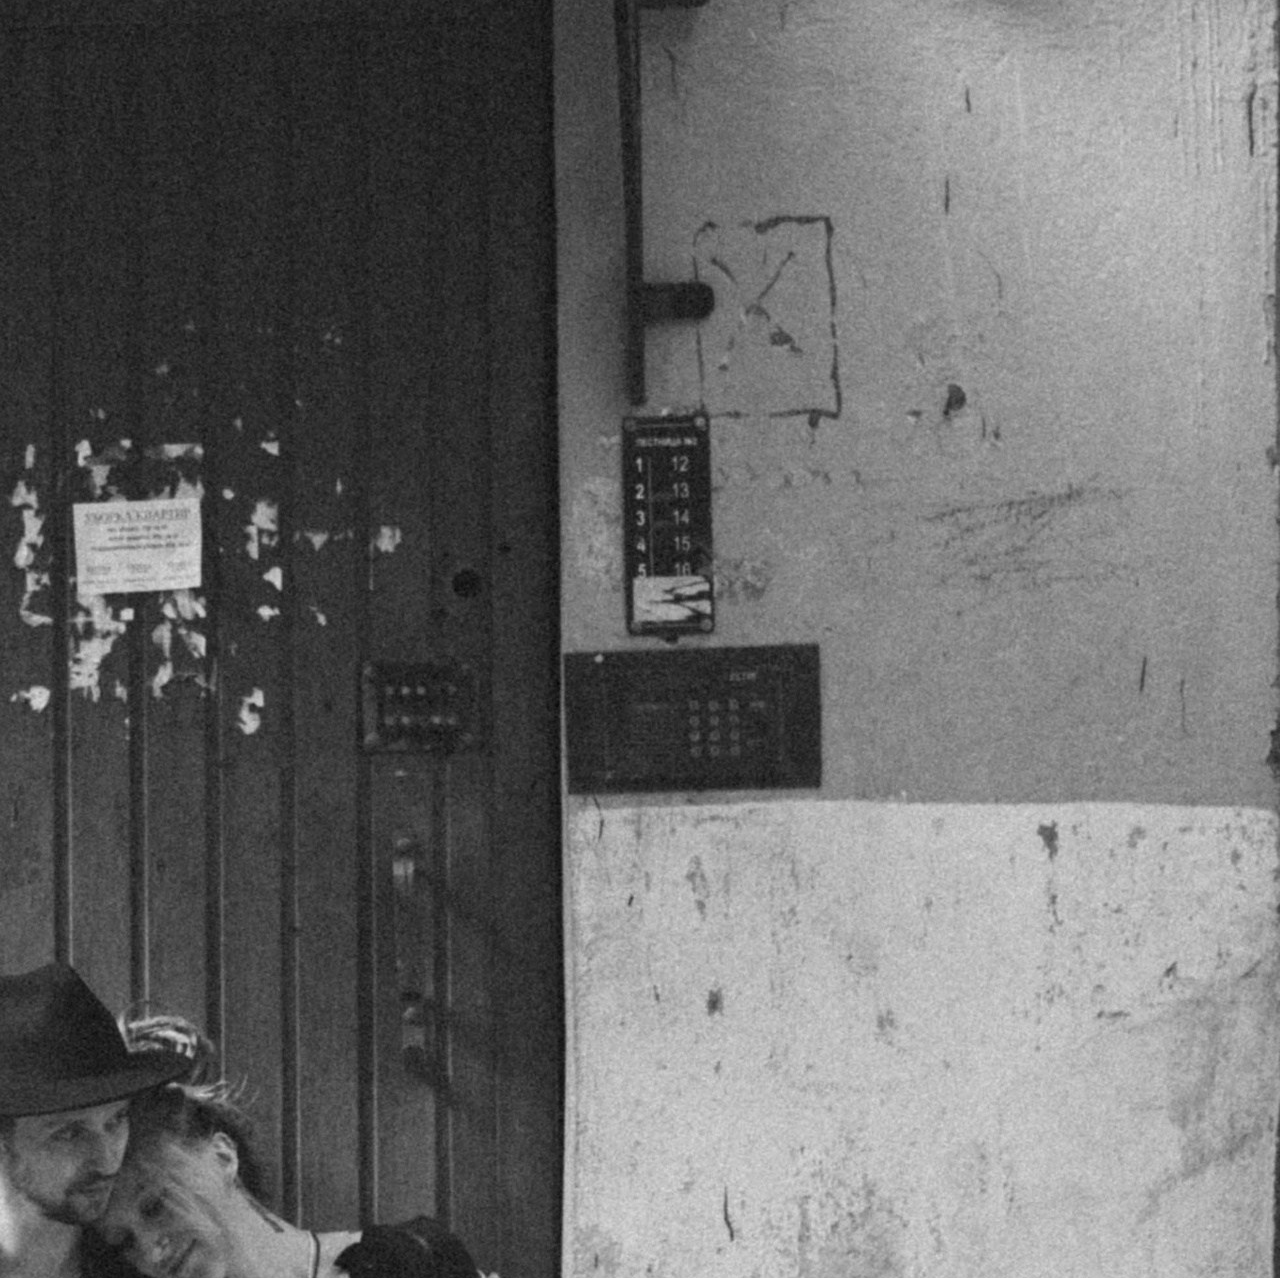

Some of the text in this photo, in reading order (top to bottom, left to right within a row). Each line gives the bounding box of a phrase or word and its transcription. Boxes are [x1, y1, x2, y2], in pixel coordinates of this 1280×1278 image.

[635, 456, 643, 473] 1
[672, 455, 690, 473] 12
[635, 483, 645, 500] 2
[672, 482, 690, 499] 13
[635, 509, 646, 526] 3
[673, 508, 690, 525] 14
[636, 536, 646, 553] 4
[674, 535, 691, 552] 15
[638, 563, 647, 579] 5
[674, 562, 691, 577] 16
